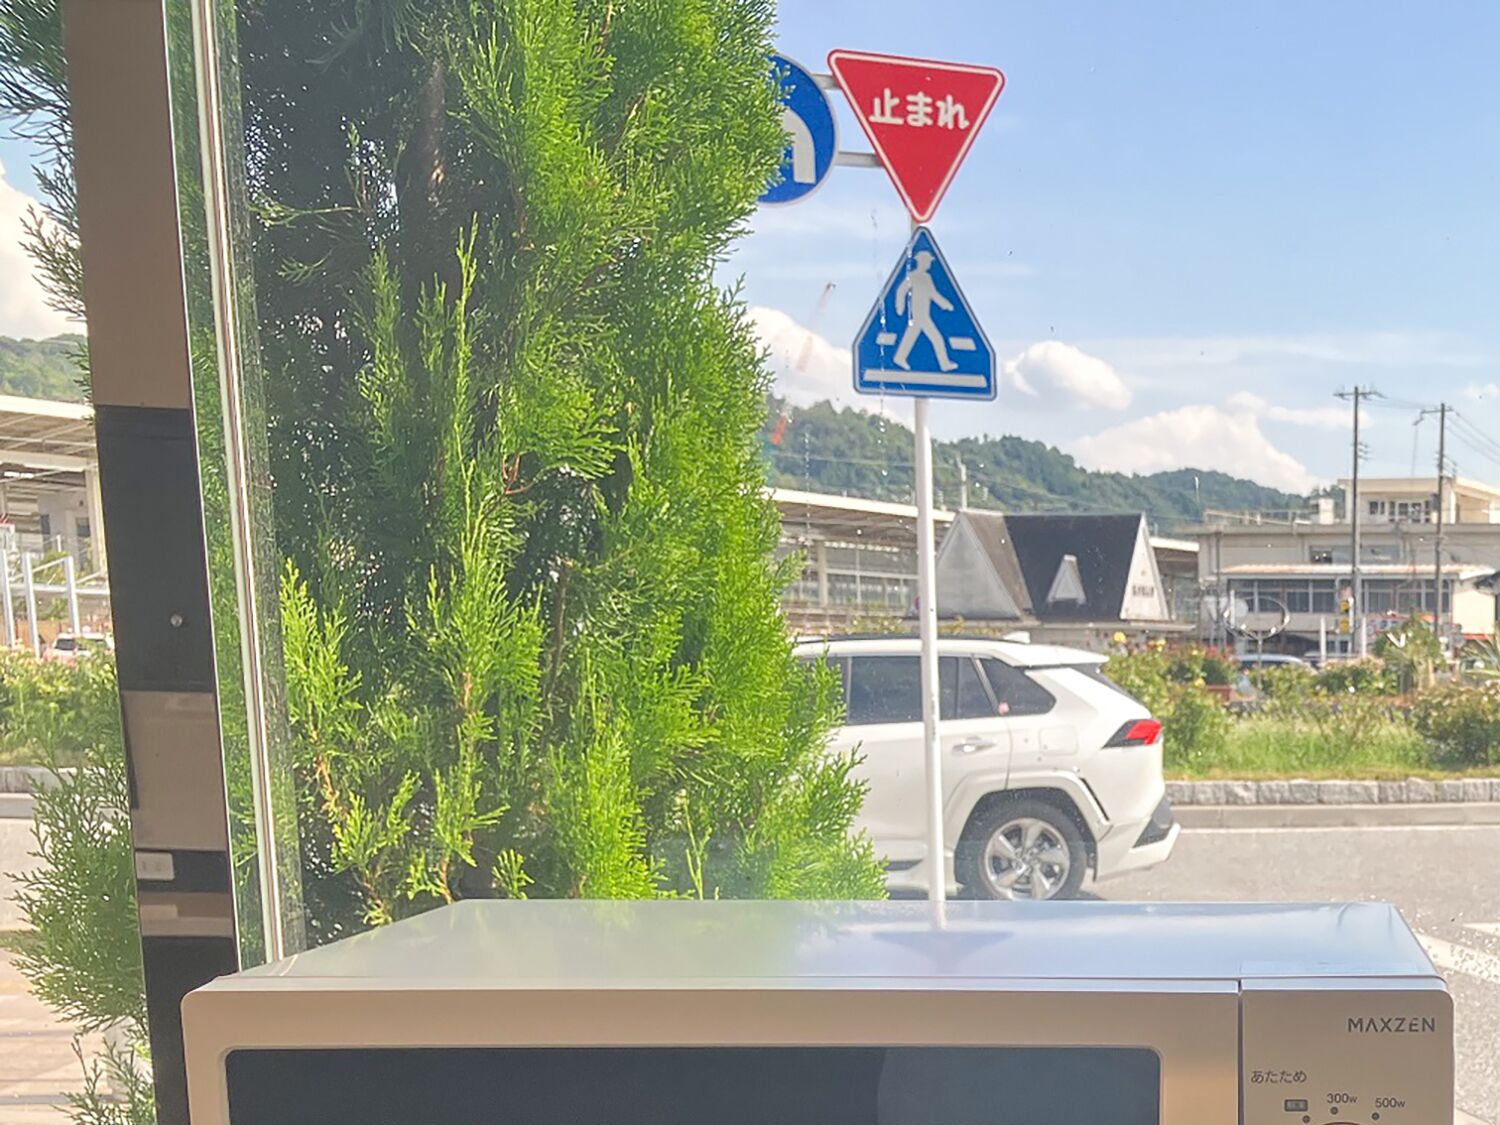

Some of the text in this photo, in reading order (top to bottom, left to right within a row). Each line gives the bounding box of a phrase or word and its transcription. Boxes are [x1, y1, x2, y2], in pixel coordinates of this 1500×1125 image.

[869, 88, 970, 131] 止まれ
[1347, 1017, 1436, 1033] MAXZEN
[1251, 1070, 1307, 1084] あたため
